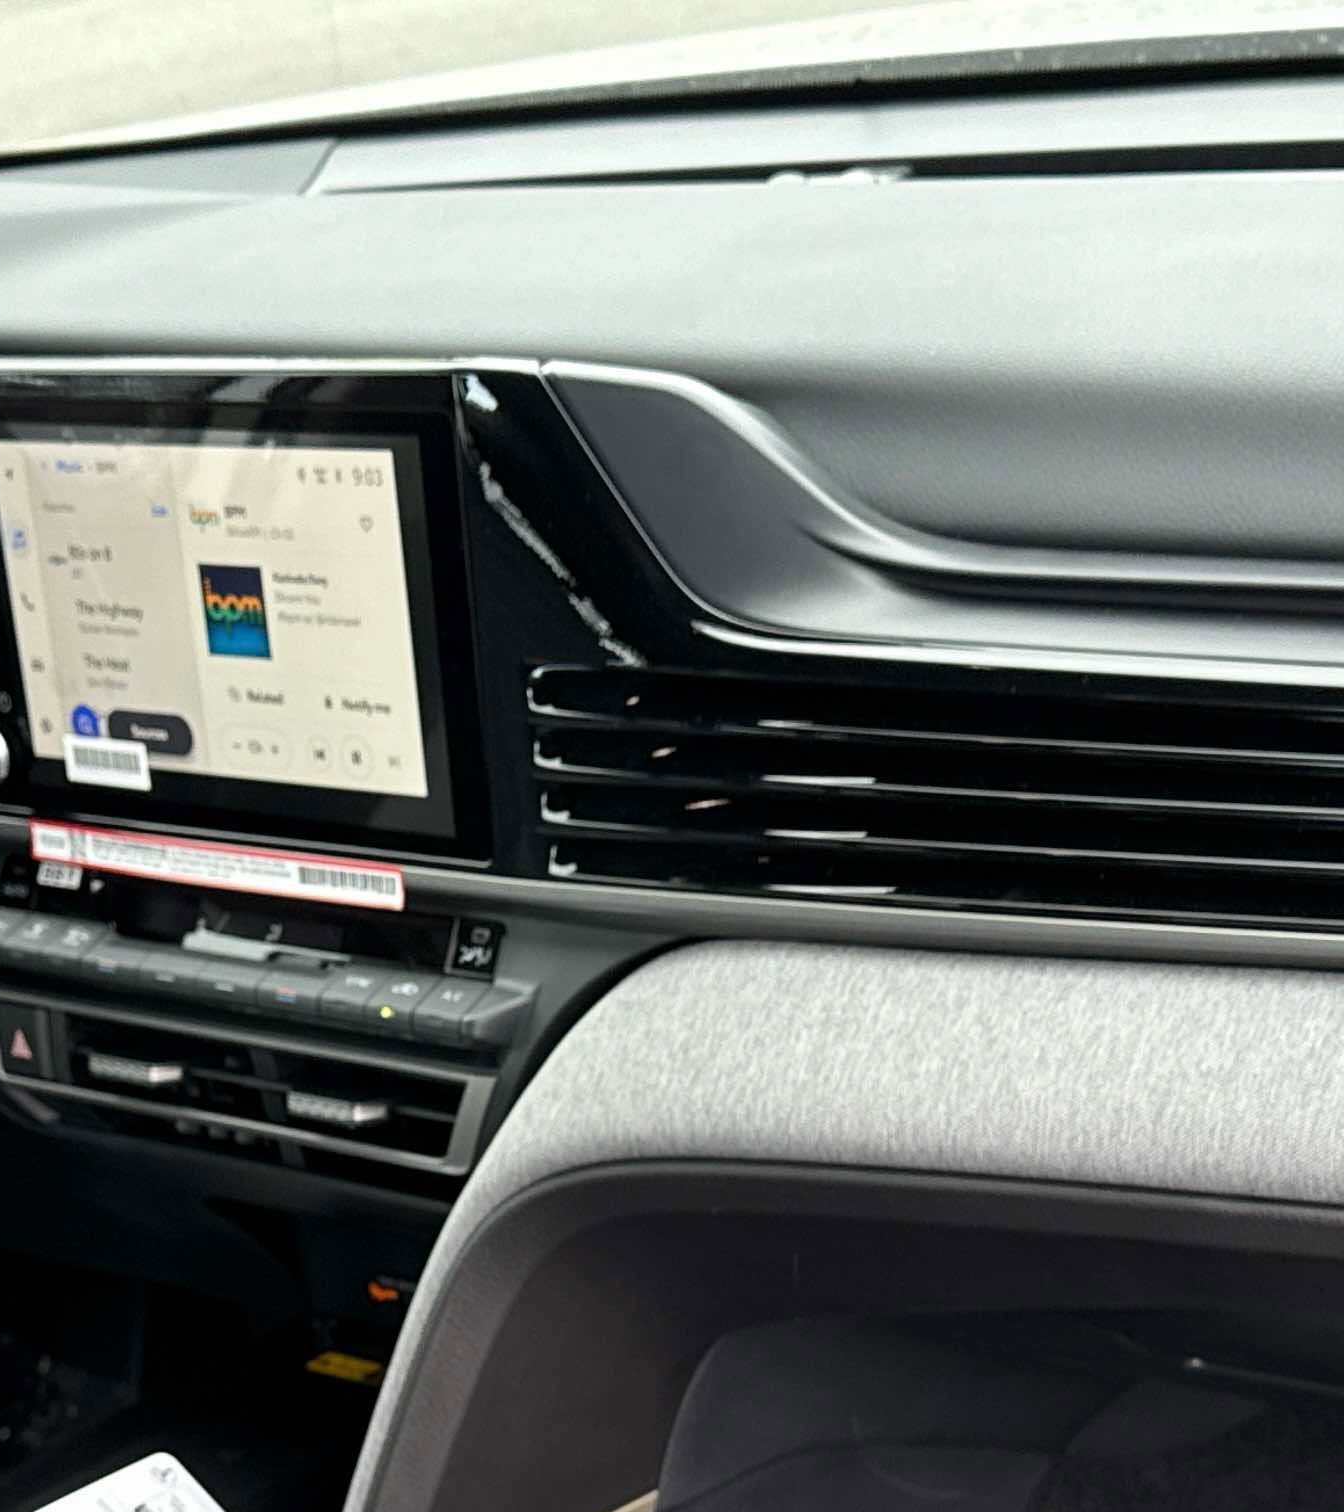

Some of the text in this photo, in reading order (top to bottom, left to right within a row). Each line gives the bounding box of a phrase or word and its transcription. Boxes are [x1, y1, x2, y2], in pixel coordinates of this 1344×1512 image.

[352, 467, 384, 487] 9:03
[75, 600, 144, 623] The Highway
[83, 652, 103, 670] The
[342, 698, 391, 717] Notify me
